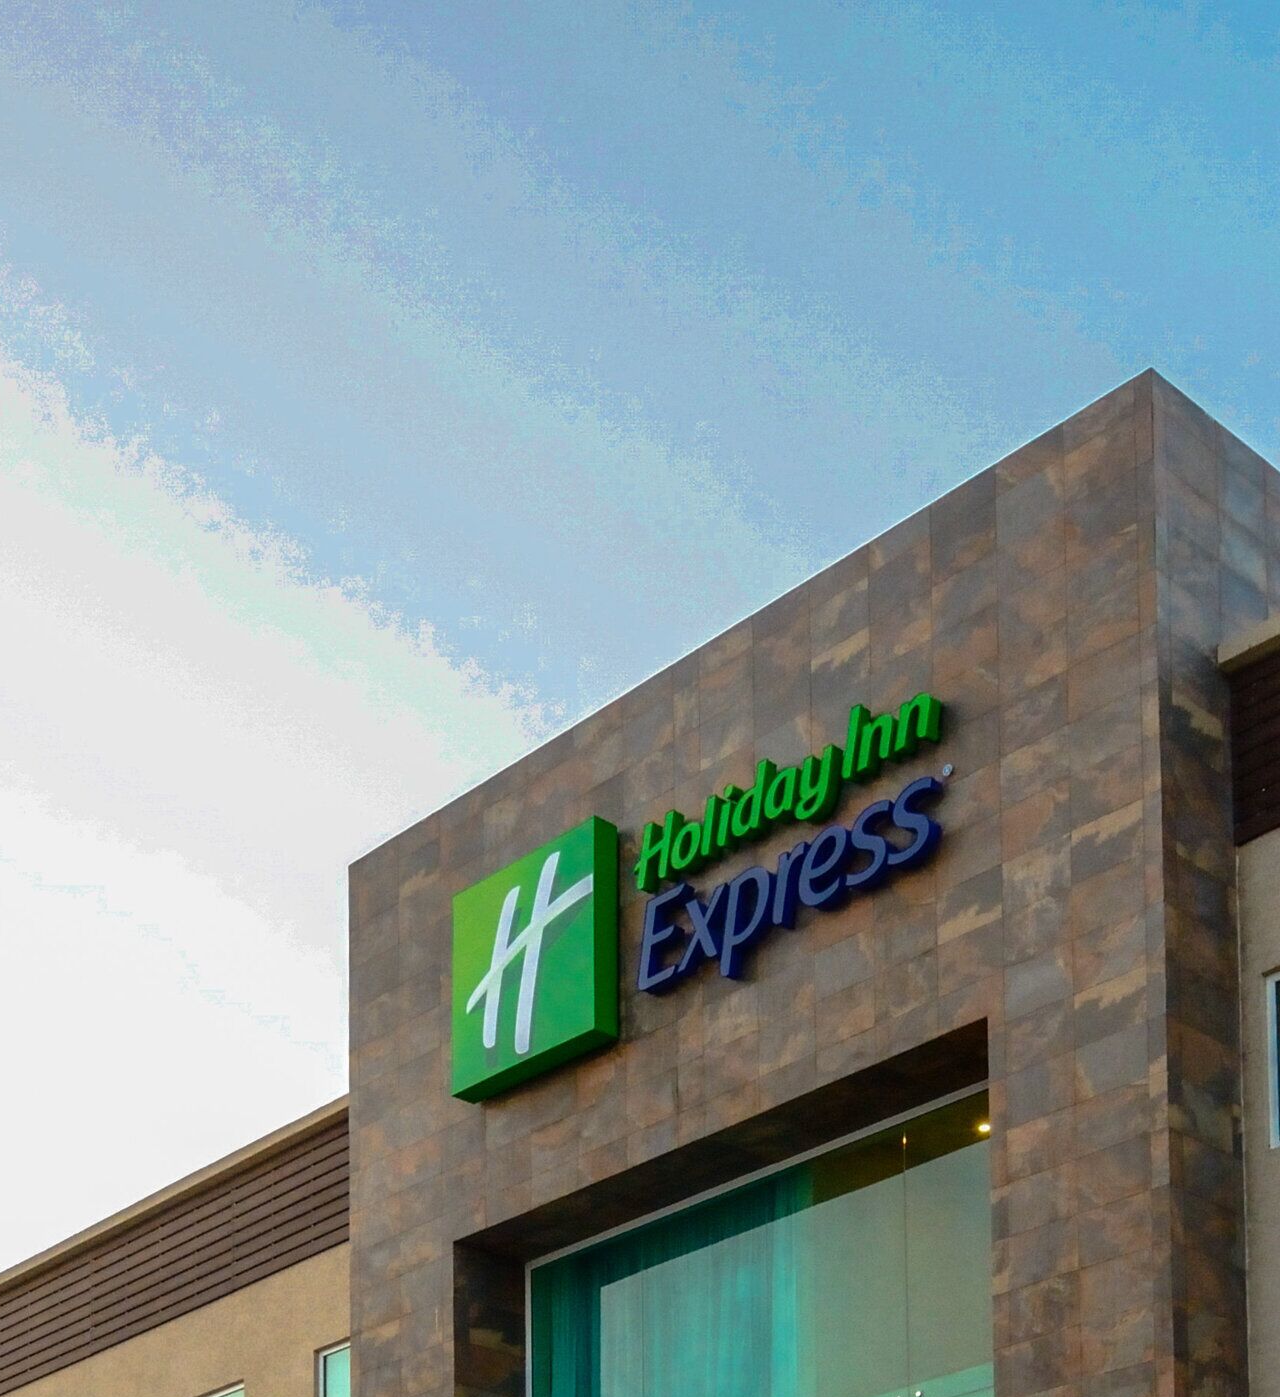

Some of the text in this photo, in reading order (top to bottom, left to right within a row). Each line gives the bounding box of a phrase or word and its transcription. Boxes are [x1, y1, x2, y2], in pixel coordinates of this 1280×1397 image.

[634, 692, 941, 892] Holiday Inn
[637, 776, 942, 992] Express
